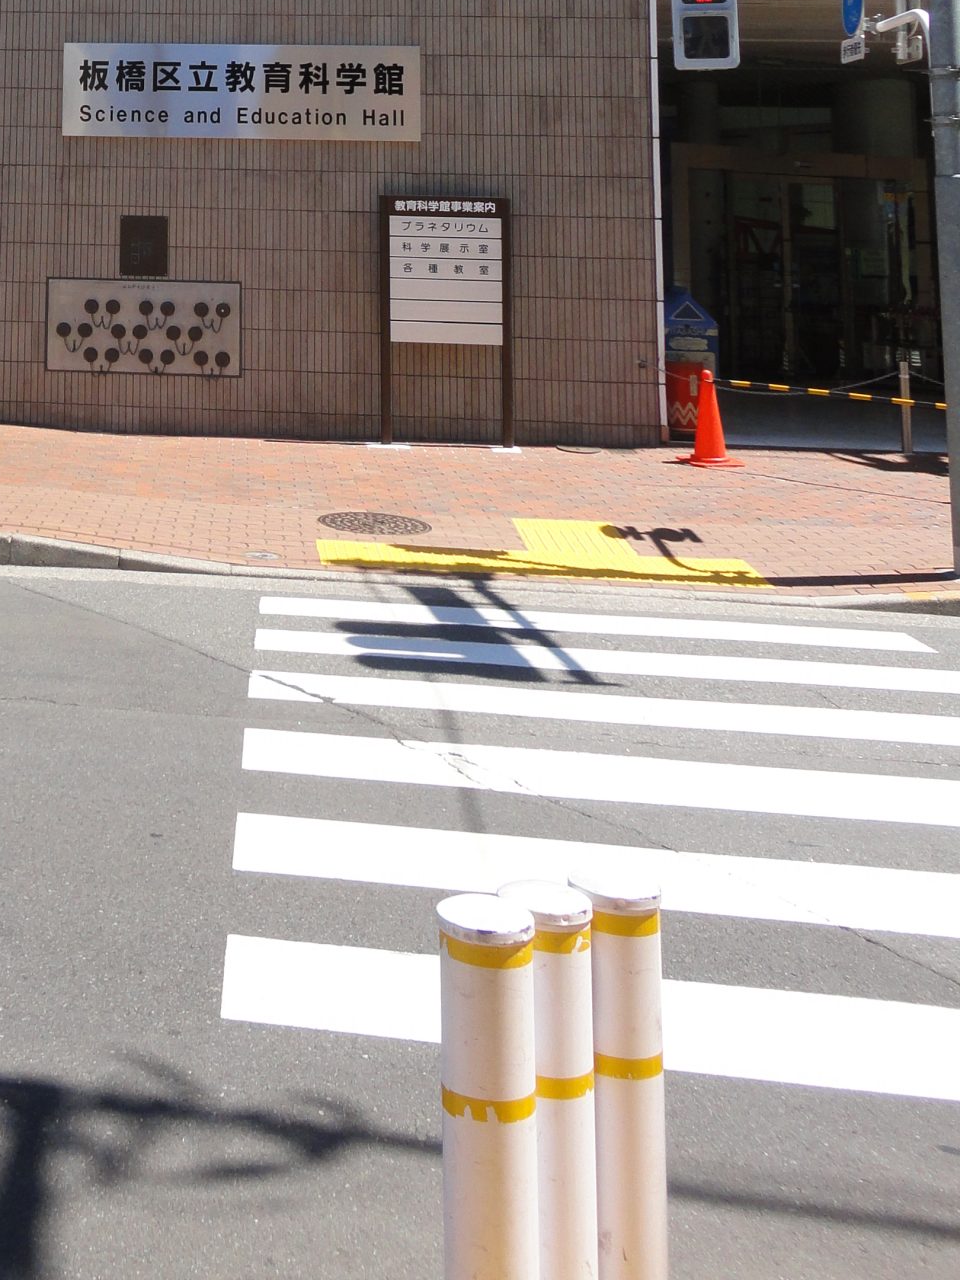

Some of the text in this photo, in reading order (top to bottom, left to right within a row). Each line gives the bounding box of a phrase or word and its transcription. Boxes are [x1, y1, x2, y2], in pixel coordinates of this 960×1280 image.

[79, 59, 404, 96] 板橋区立教育科学館
[79, 105, 404, 126] Science and Education Hall
[394, 200, 496, 213] 教育科学館事業案内
[401, 221, 489, 233] プラネタリウム
[402, 242, 489, 254] 科学展示室
[403, 263, 489, 275] 各種教室
